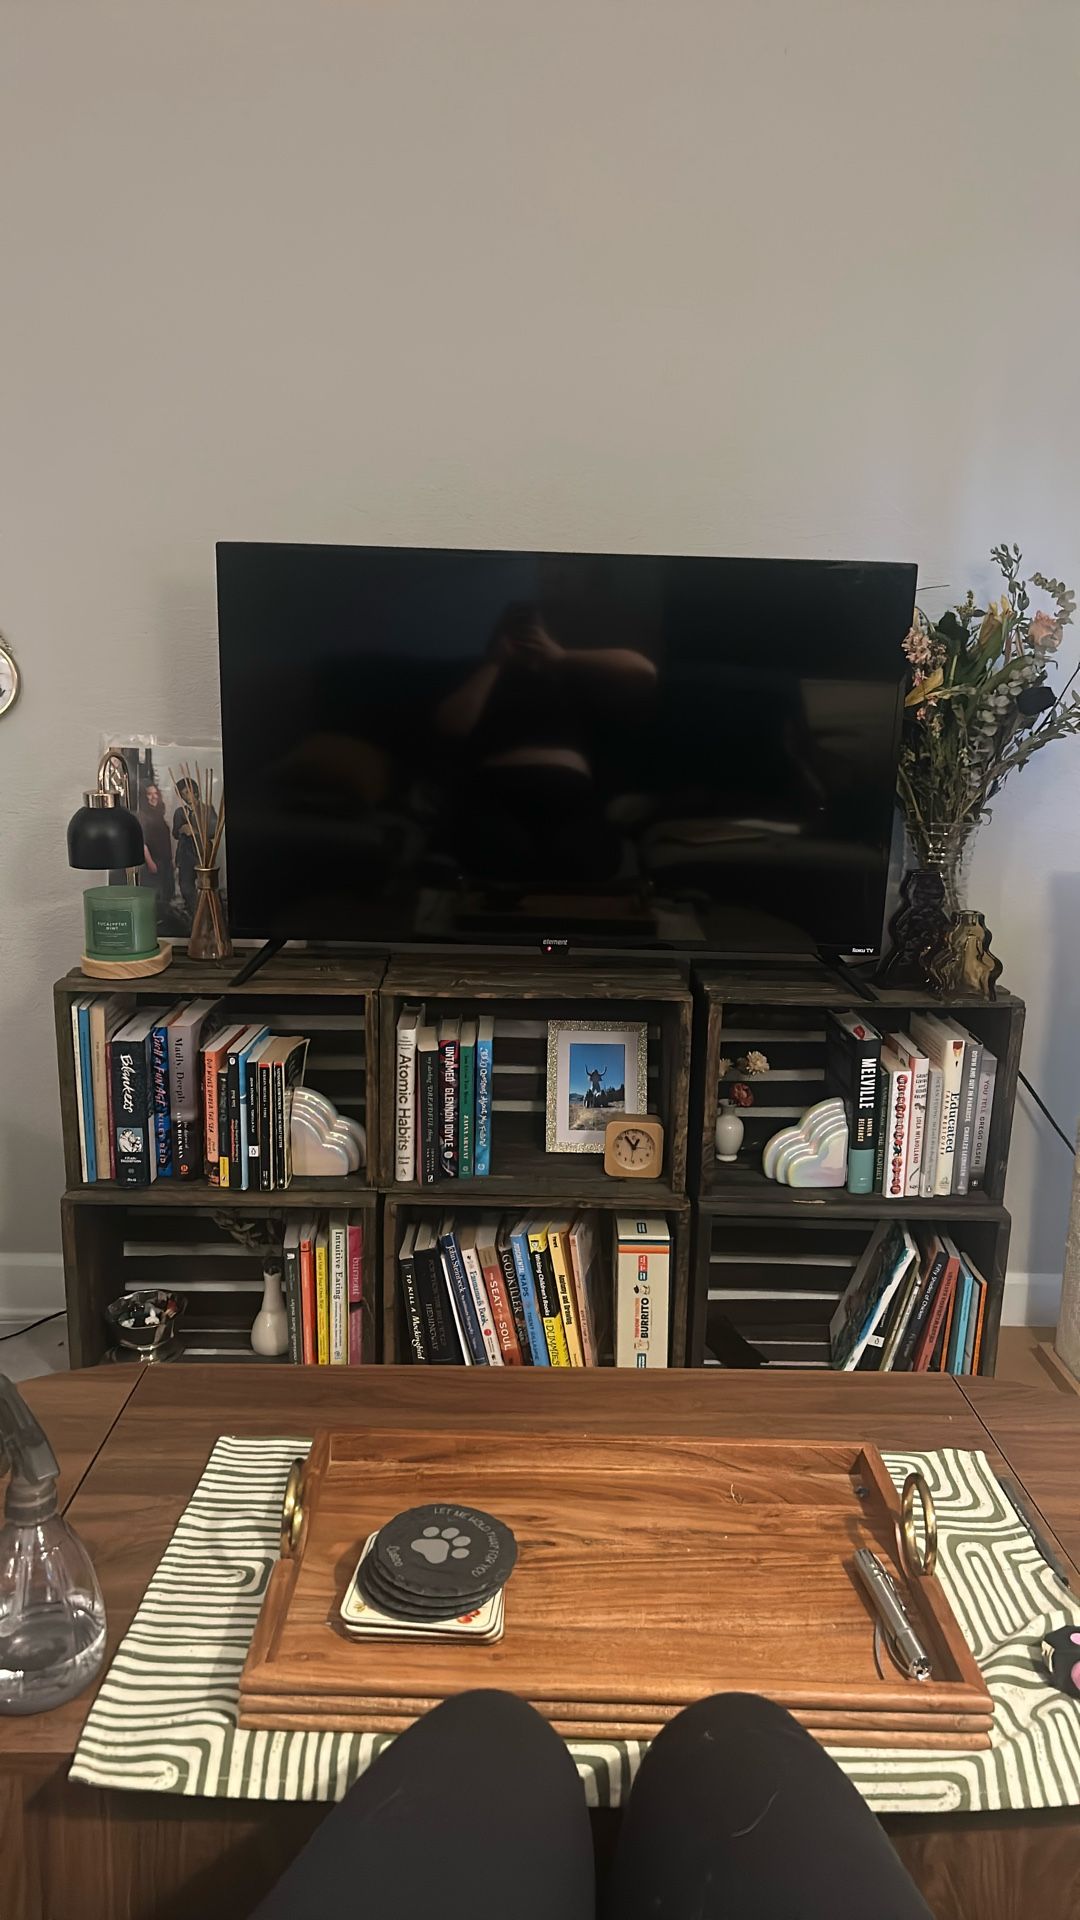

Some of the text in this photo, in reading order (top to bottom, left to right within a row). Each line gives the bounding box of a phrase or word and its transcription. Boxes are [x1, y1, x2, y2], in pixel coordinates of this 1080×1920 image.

[542, 938, 568, 946] element
[120, 1053, 136, 1114] Blankets
[398, 1054, 412, 1151] Atomic Habits
[444, 1046, 455, 1148] UNTAMED GLENNON DOYLE
[859, 1058, 876, 1109] MELVILLE
[982, 1080, 990, 1095] YOU
[940, 1116, 948, 1155] WESTOVER
[946, 1093, 959, 1153] Educated
[335, 1231, 343, 1268] Intuitive
[446, 1245, 466, 1293] John Steinbeck
[333, 1272, 343, 1300] Eating
[502, 1254, 522, 1313] GODKILLER
[520, 1274, 528, 1296] MAPS
[538, 1274, 547, 1299] Children's
[406, 1274, 412, 1284] TO
[412, 1315, 425, 1360] Mockingbird
[490, 1280, 502, 1308] SEAT
[500, 1321, 511, 1350] SOUL
[542, 1299, 550, 1316] Books
[641, 1297, 649, 1338] BURRITO
[546, 1325, 560, 1366] DUMMIES
[434, 1507, 452, 1515] LET
[454, 1510, 471, 1519] ME
[471, 1564, 491, 1578] YOU
